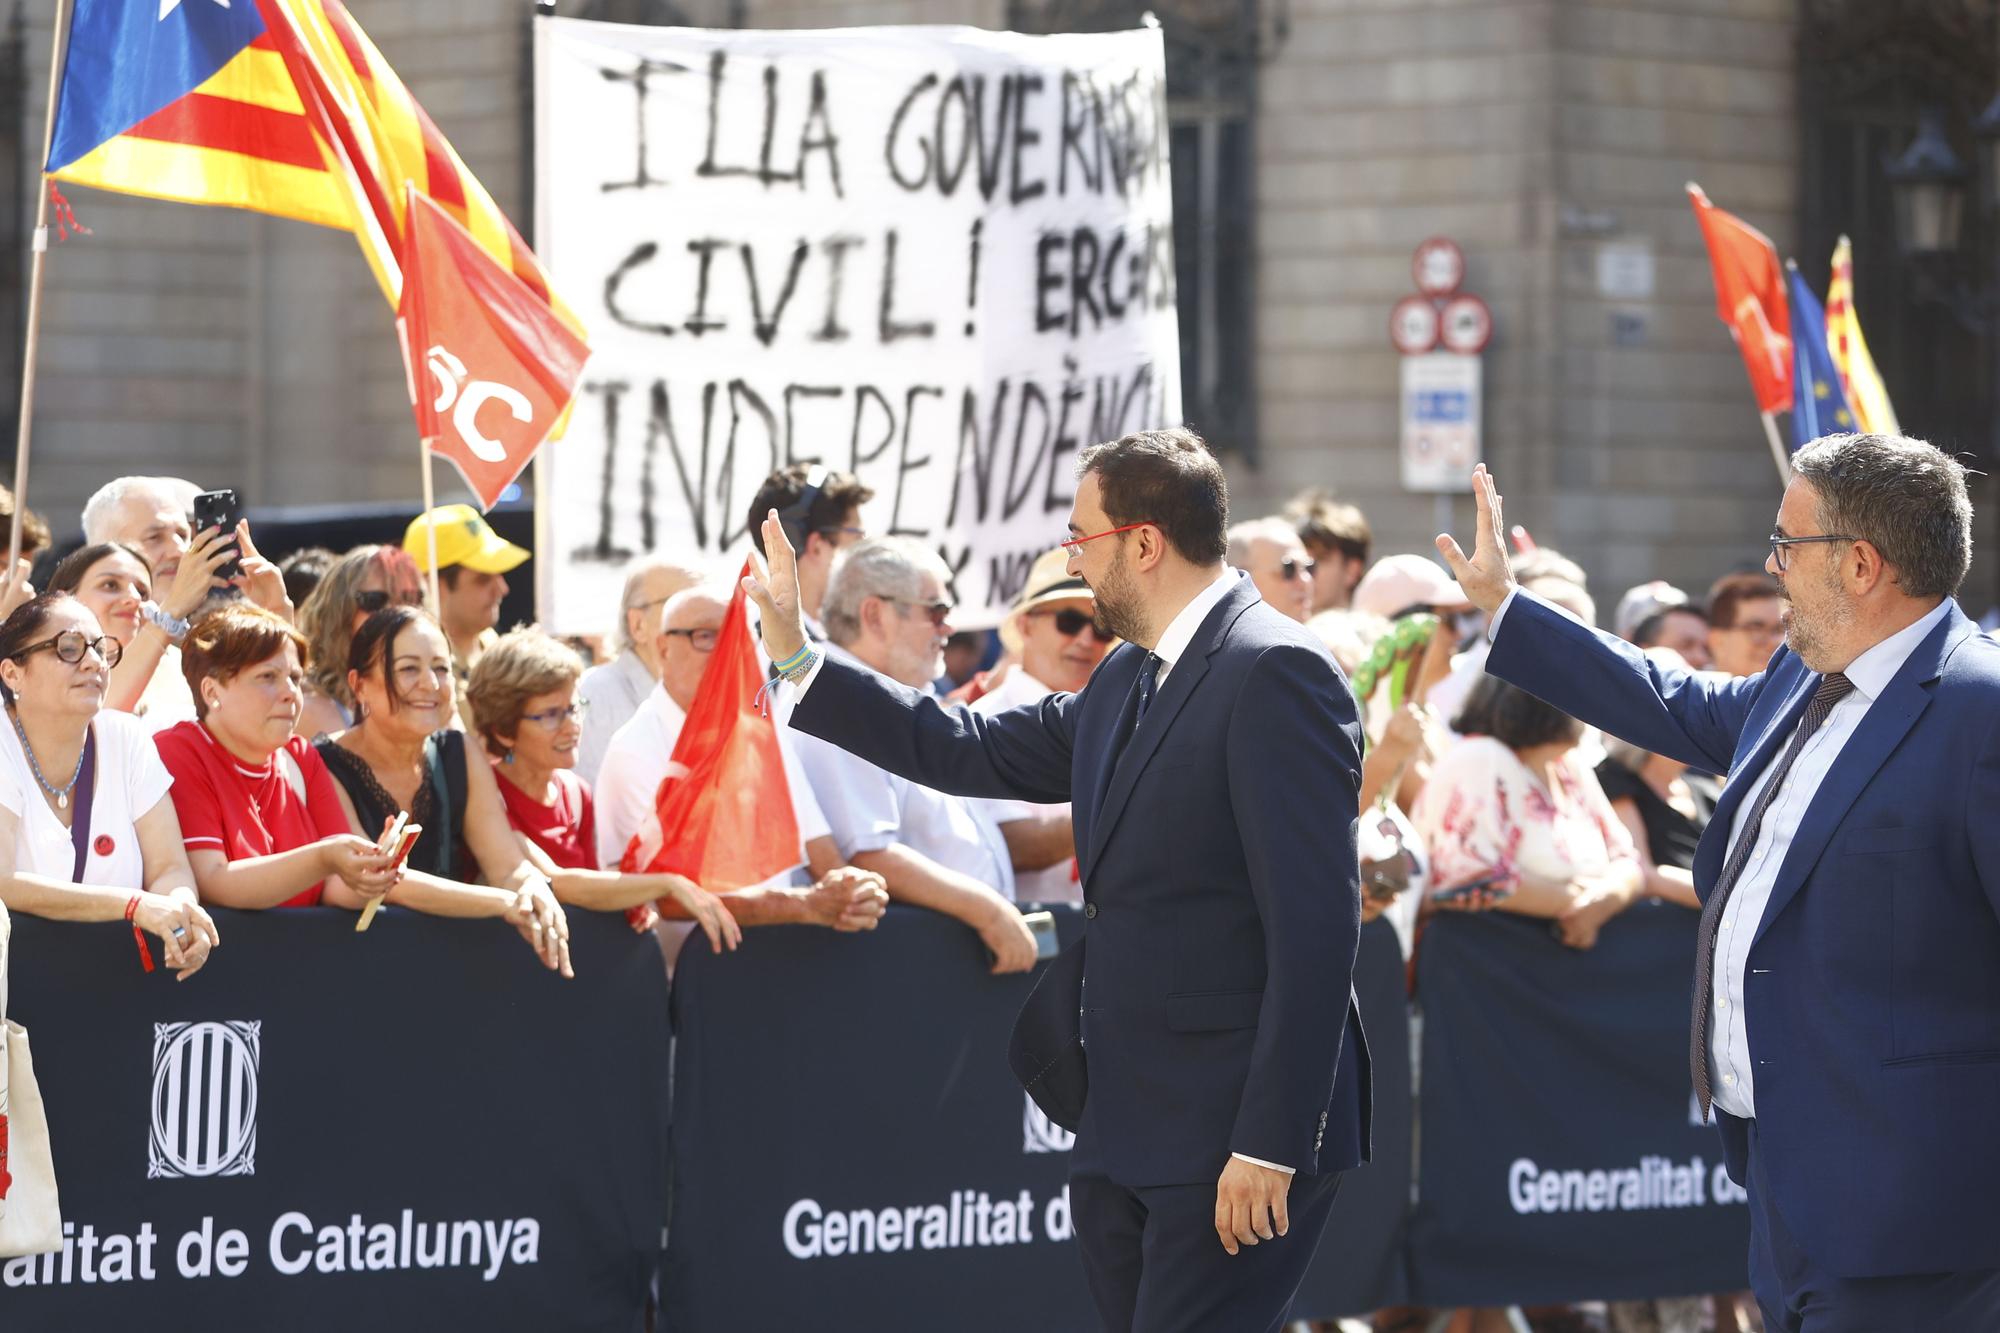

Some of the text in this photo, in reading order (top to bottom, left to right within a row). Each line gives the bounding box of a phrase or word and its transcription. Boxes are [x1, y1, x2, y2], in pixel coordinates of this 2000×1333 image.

[600, 50, 844, 198] ILLA
[1508, 1155, 1706, 1213] Generalitat
[176, 1216, 250, 1279] de
[269, 1208, 541, 1282] Catalunya
[783, 1189, 1034, 1260] Generalitat
